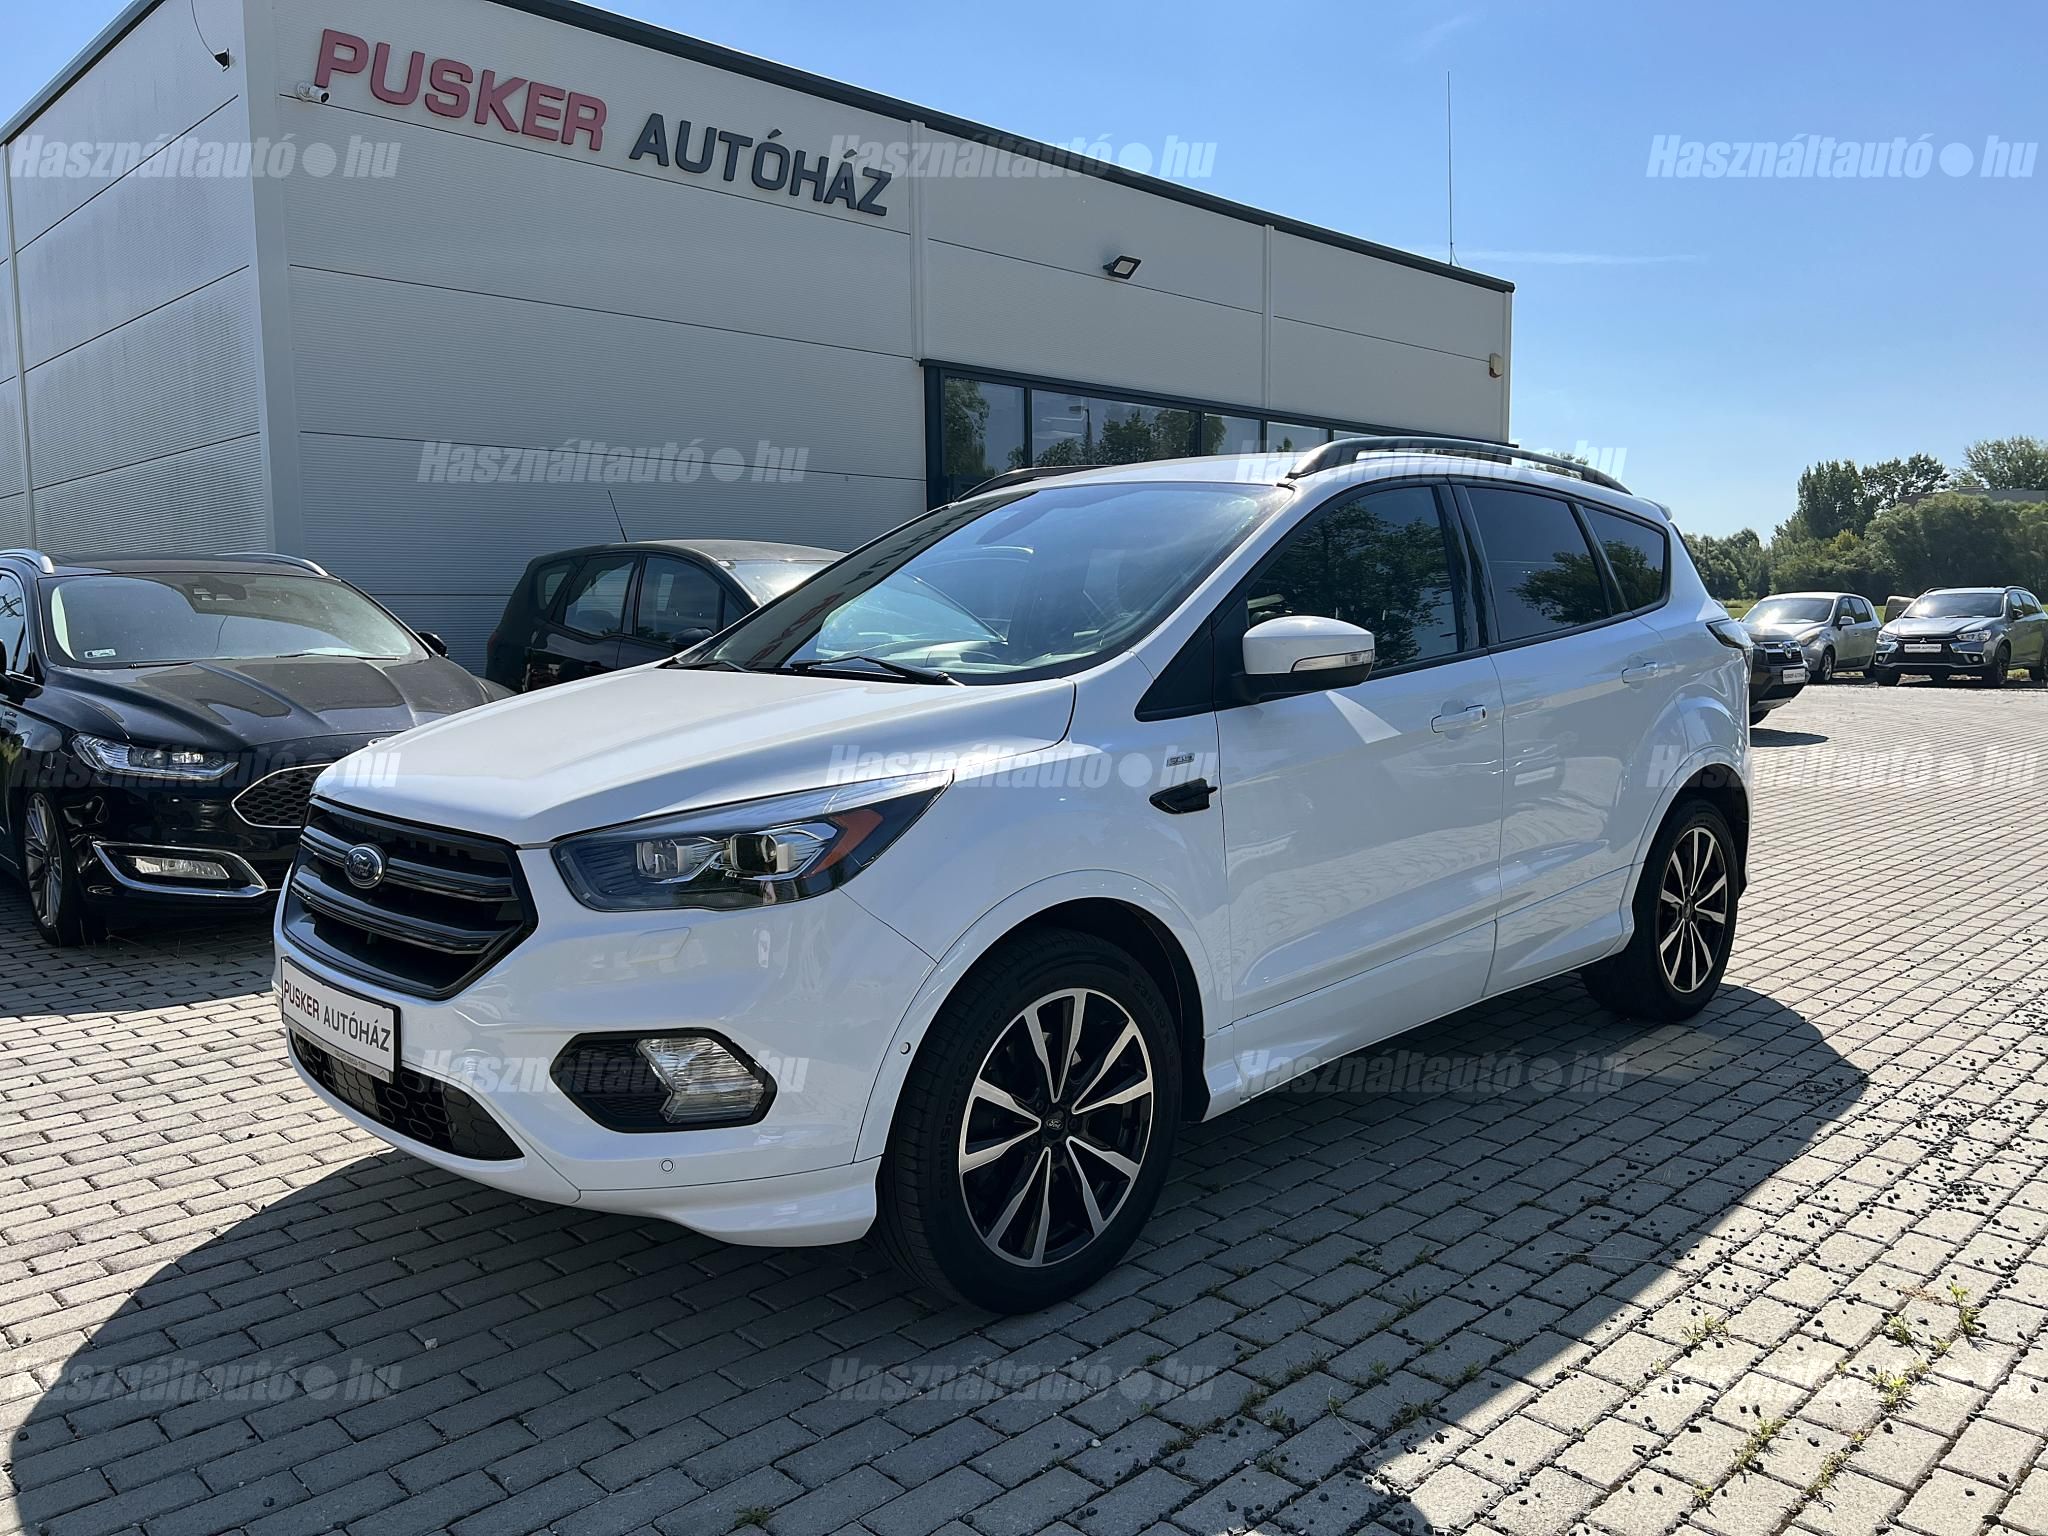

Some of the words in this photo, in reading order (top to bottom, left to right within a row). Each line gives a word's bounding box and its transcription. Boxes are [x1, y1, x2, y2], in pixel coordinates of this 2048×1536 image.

[314, 28, 608, 151] PUSKER
[629, 113, 893, 216] AUTÓHÁZ
[283, 979, 320, 1021] PUSKER
[323, 1005, 391, 1053] AUTÓHÁZ
